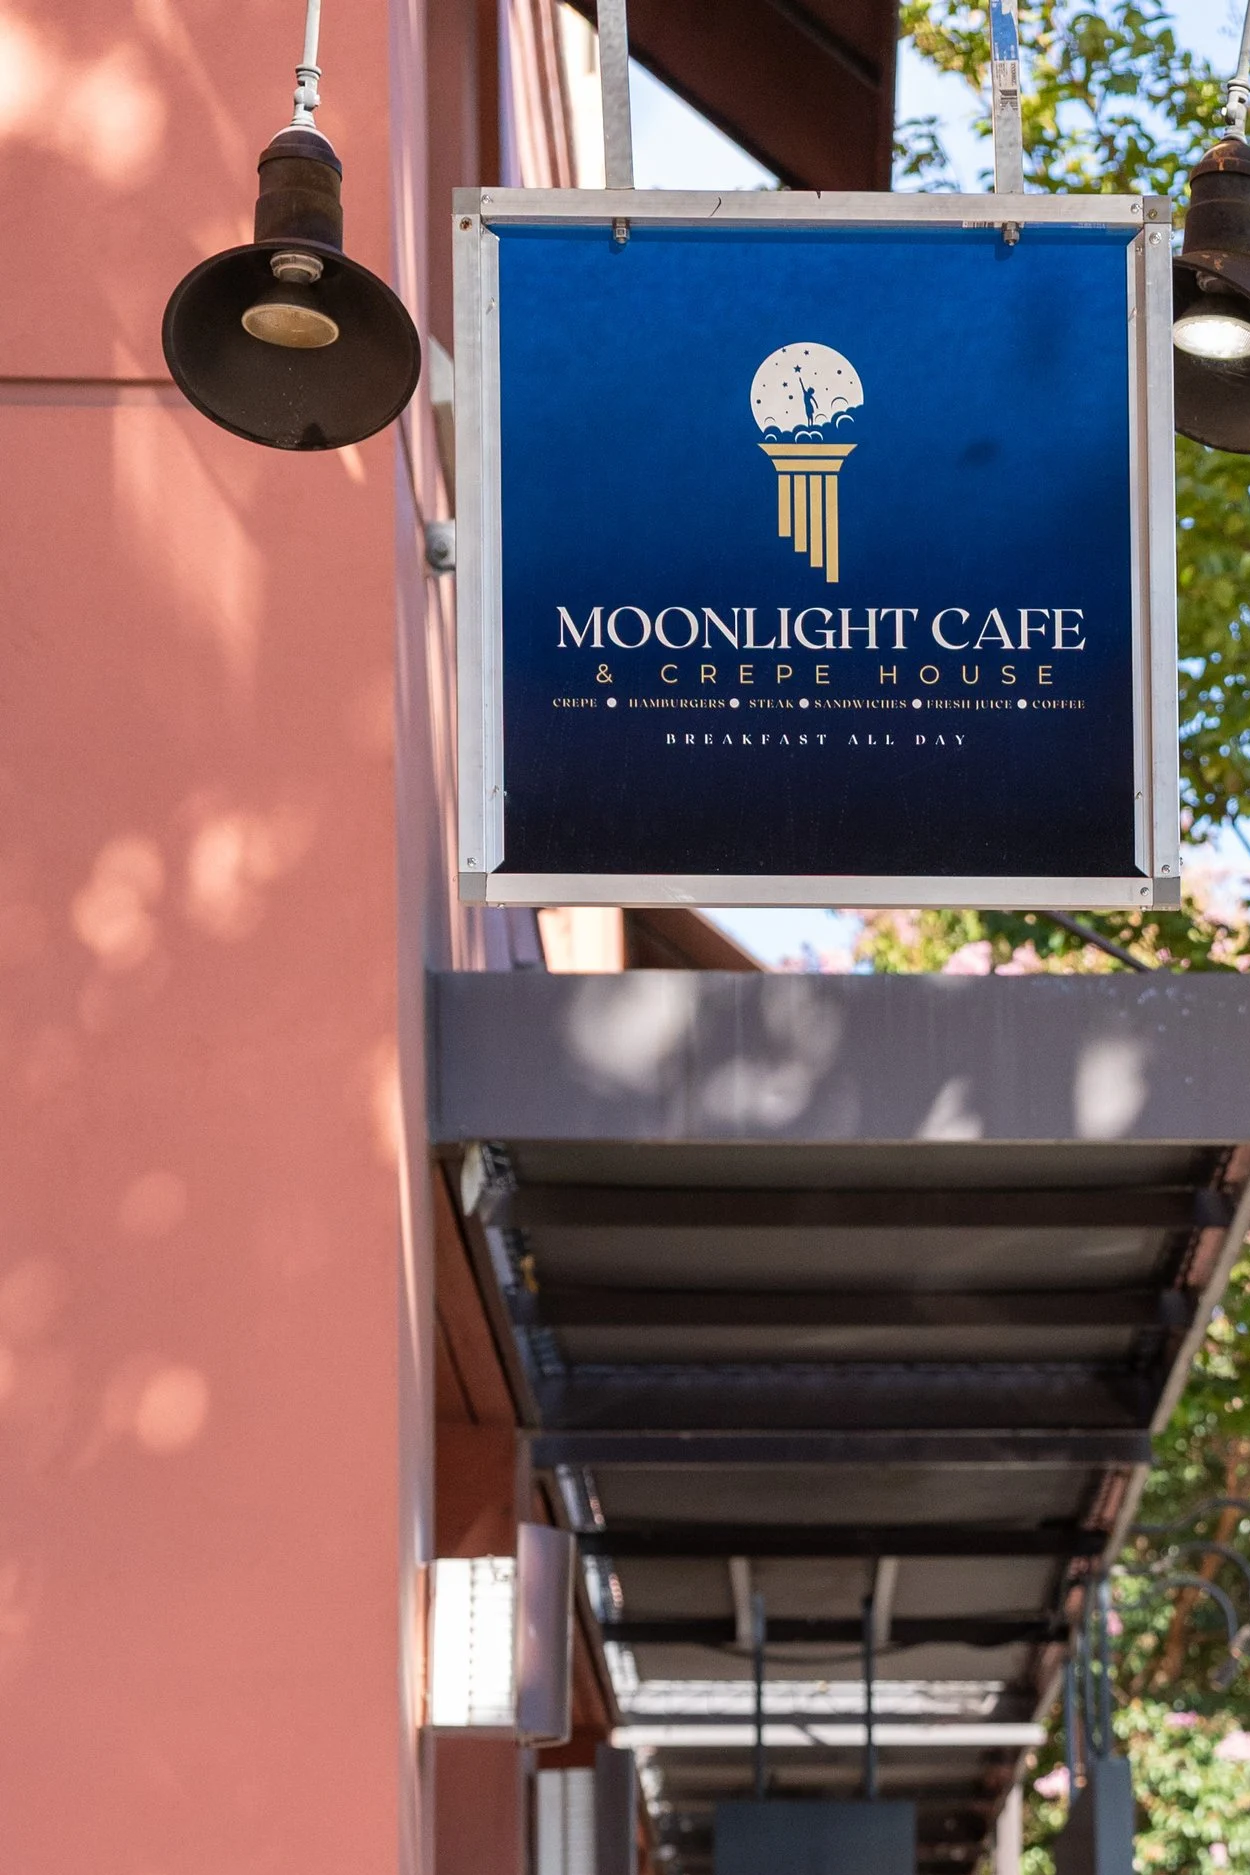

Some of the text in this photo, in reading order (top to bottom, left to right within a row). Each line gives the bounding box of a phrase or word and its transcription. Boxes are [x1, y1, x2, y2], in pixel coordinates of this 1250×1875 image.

[556, 606, 1087, 650] MOONLIGHT CAFE
[595, 663, 1054, 685] & CREPE HOUSE
[552, 698, 1086, 710] CREPE HAMBURGERS STEAK SANDWICHES FRESH JUICE COFFEE
[666, 733, 965, 746] BREAKFAST ALL DAY
